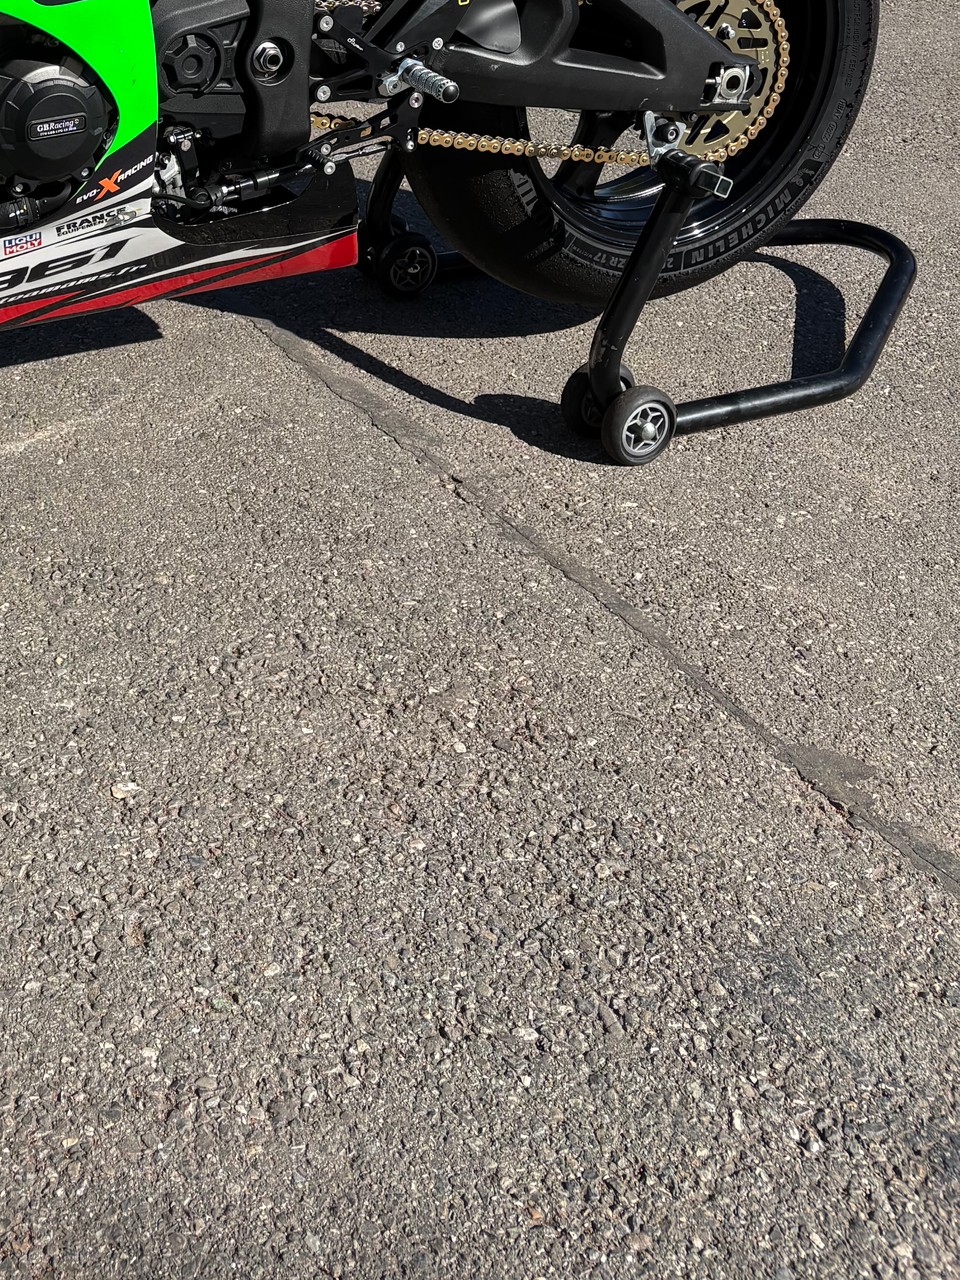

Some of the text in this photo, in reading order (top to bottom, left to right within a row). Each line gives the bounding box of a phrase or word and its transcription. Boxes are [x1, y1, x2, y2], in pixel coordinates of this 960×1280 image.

[37, 120, 74, 133] GBRacing
[55, 207, 127, 234] FRANCE
[690, 188, 792, 264] MICHELIN
[4, 232, 41, 248] LIQUI
[5, 239, 41, 255] MOLY
